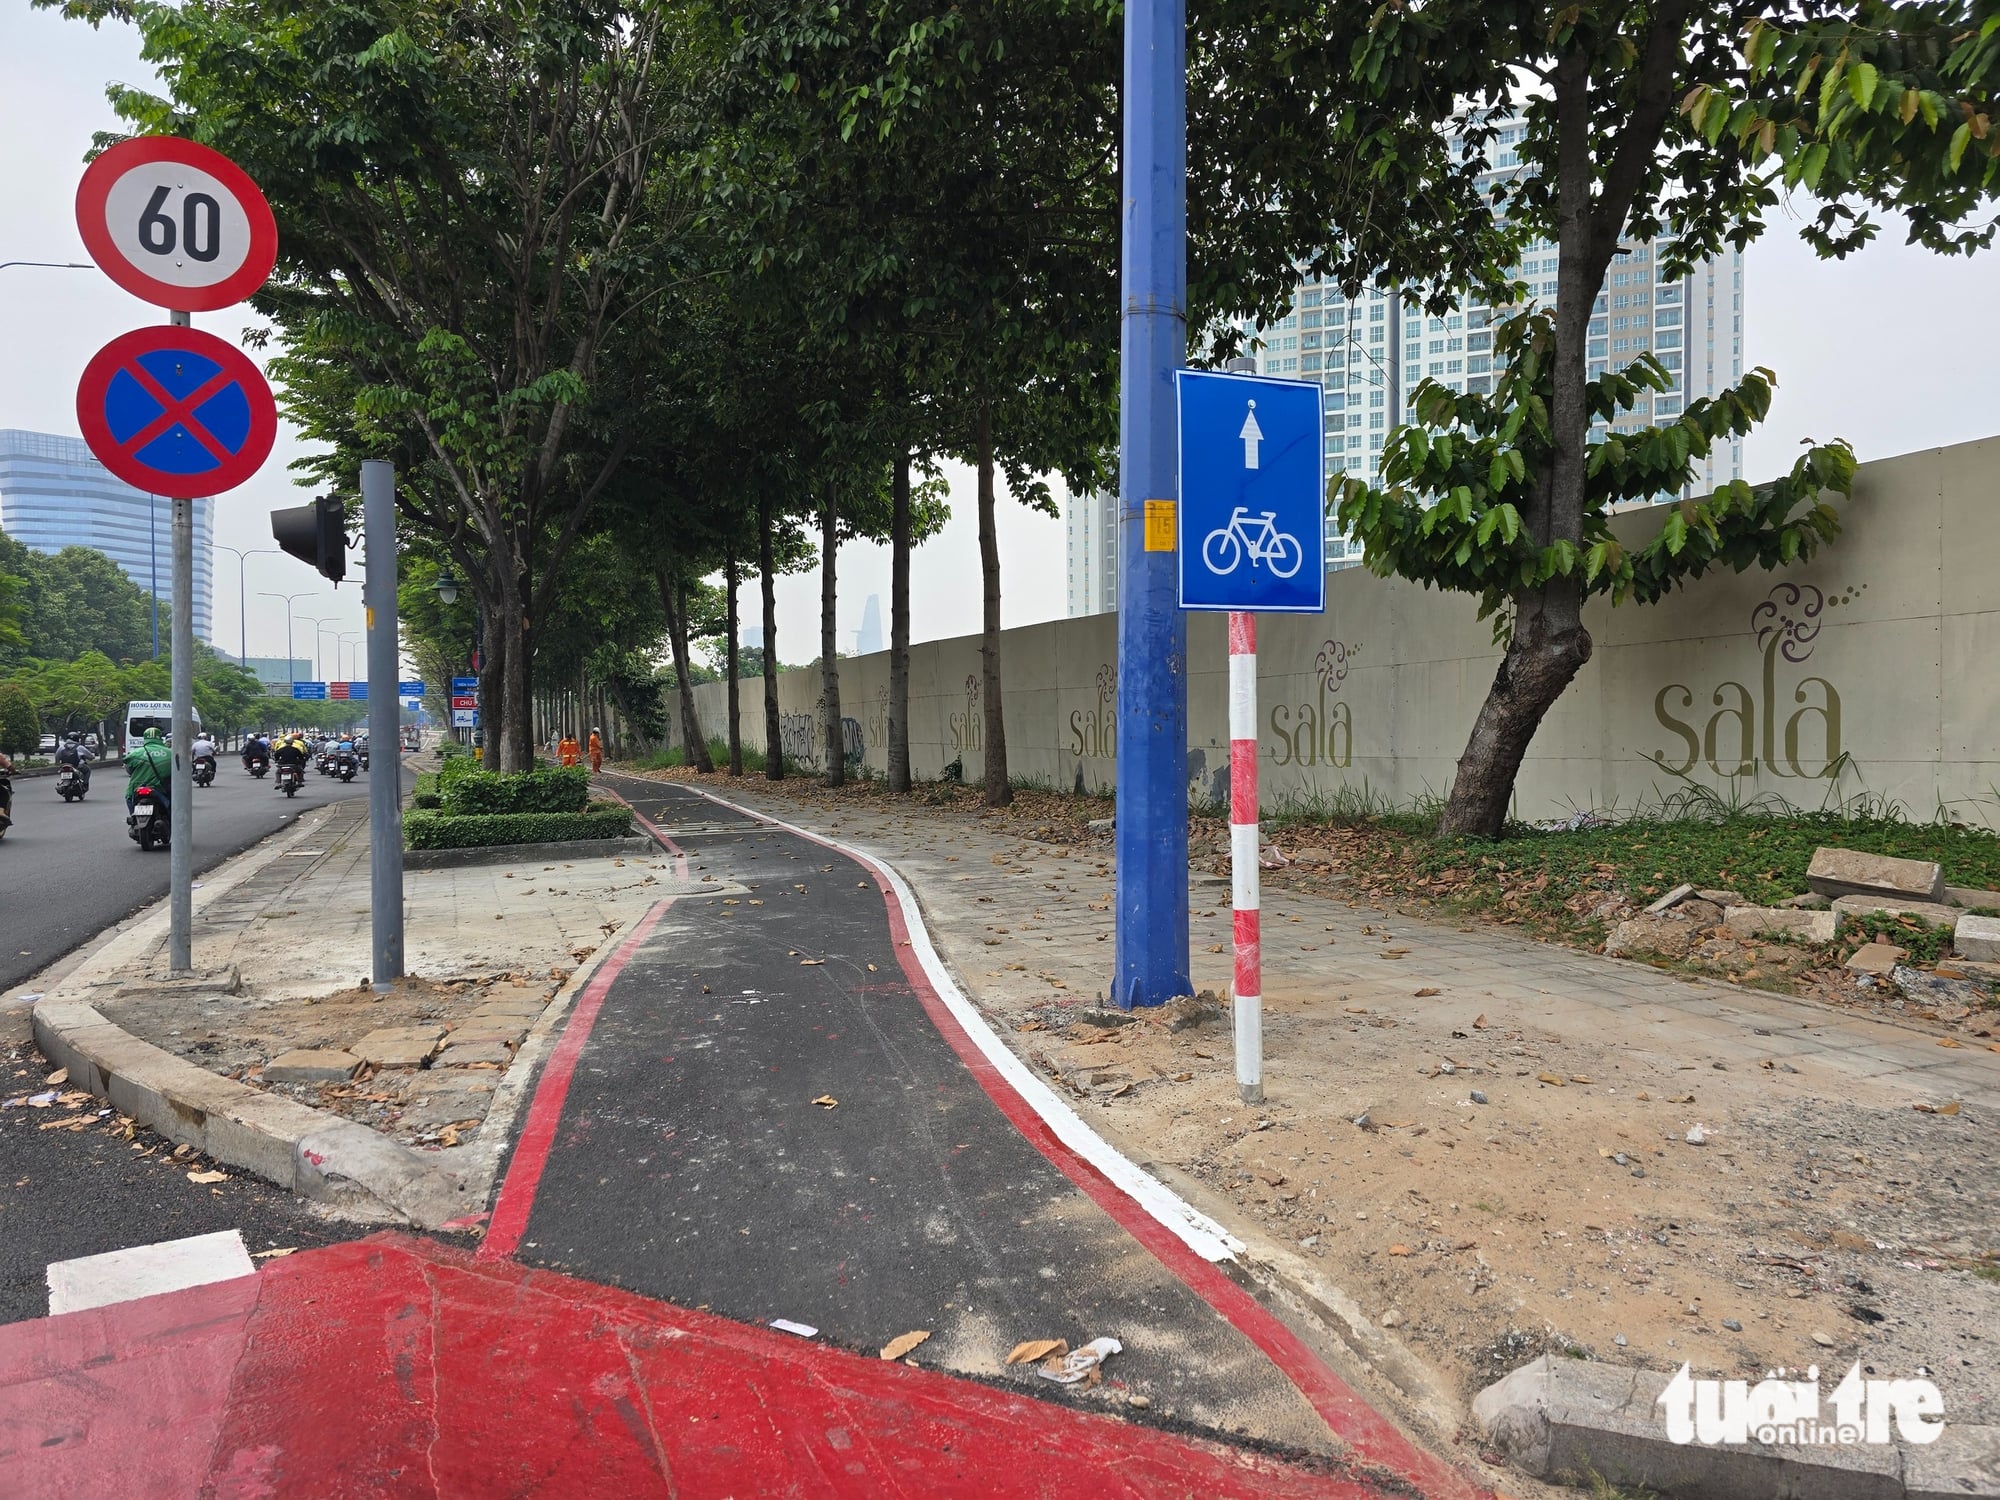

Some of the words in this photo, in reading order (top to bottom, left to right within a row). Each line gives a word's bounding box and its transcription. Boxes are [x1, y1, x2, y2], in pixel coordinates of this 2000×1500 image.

[139, 185, 220, 263] 60
[950, 692, 981, 752] sala
[1070, 684, 1117, 759] sala
[1270, 670, 1352, 768] sala
[1654, 626, 1841, 779] sala
